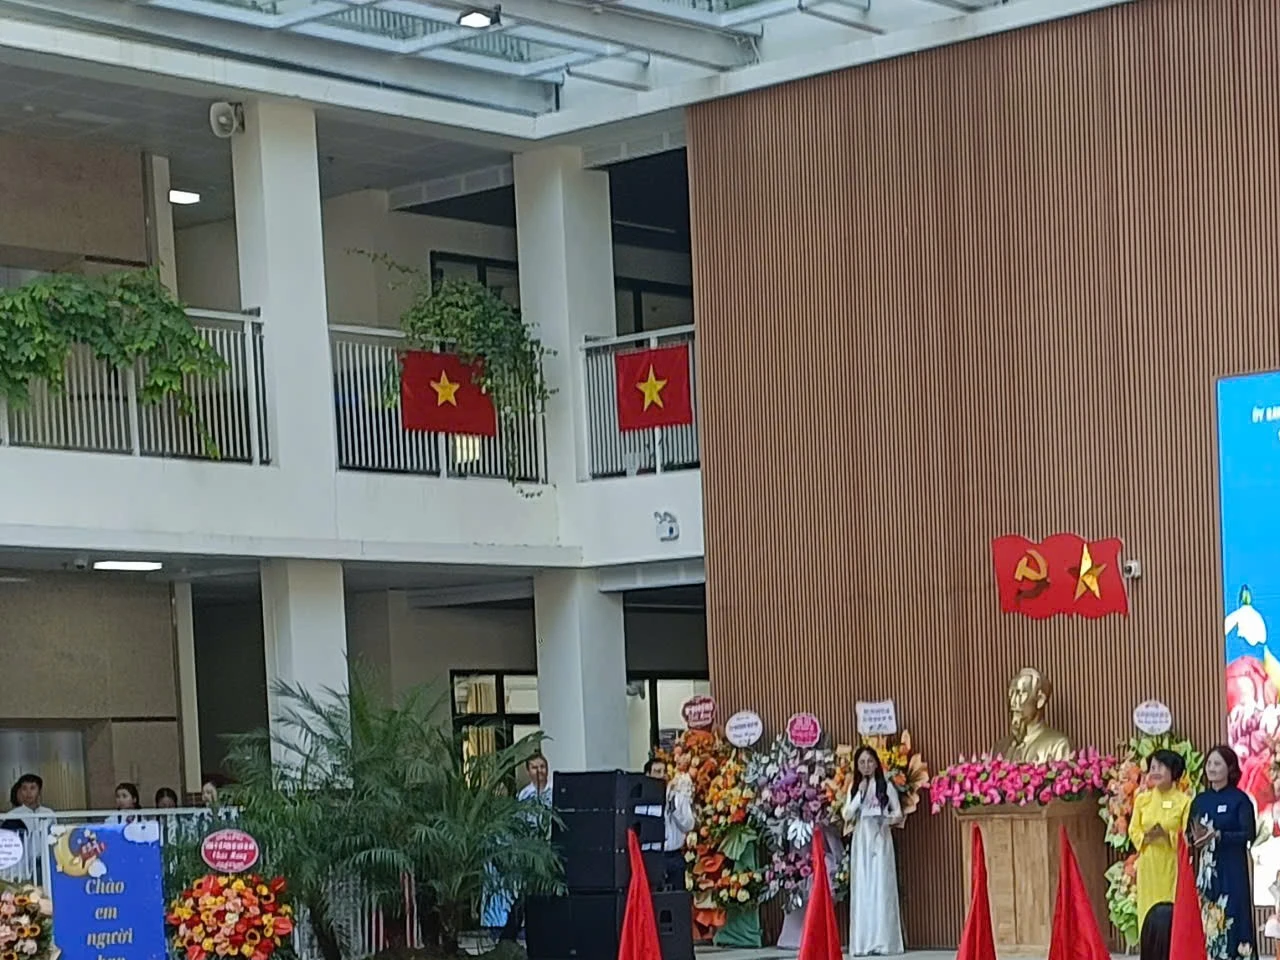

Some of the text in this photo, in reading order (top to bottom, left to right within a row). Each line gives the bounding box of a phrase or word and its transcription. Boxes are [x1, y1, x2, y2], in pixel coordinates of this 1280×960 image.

[85, 877, 125, 895] Chào
[95, 906, 118, 920] em
[87, 927, 134, 949] người
